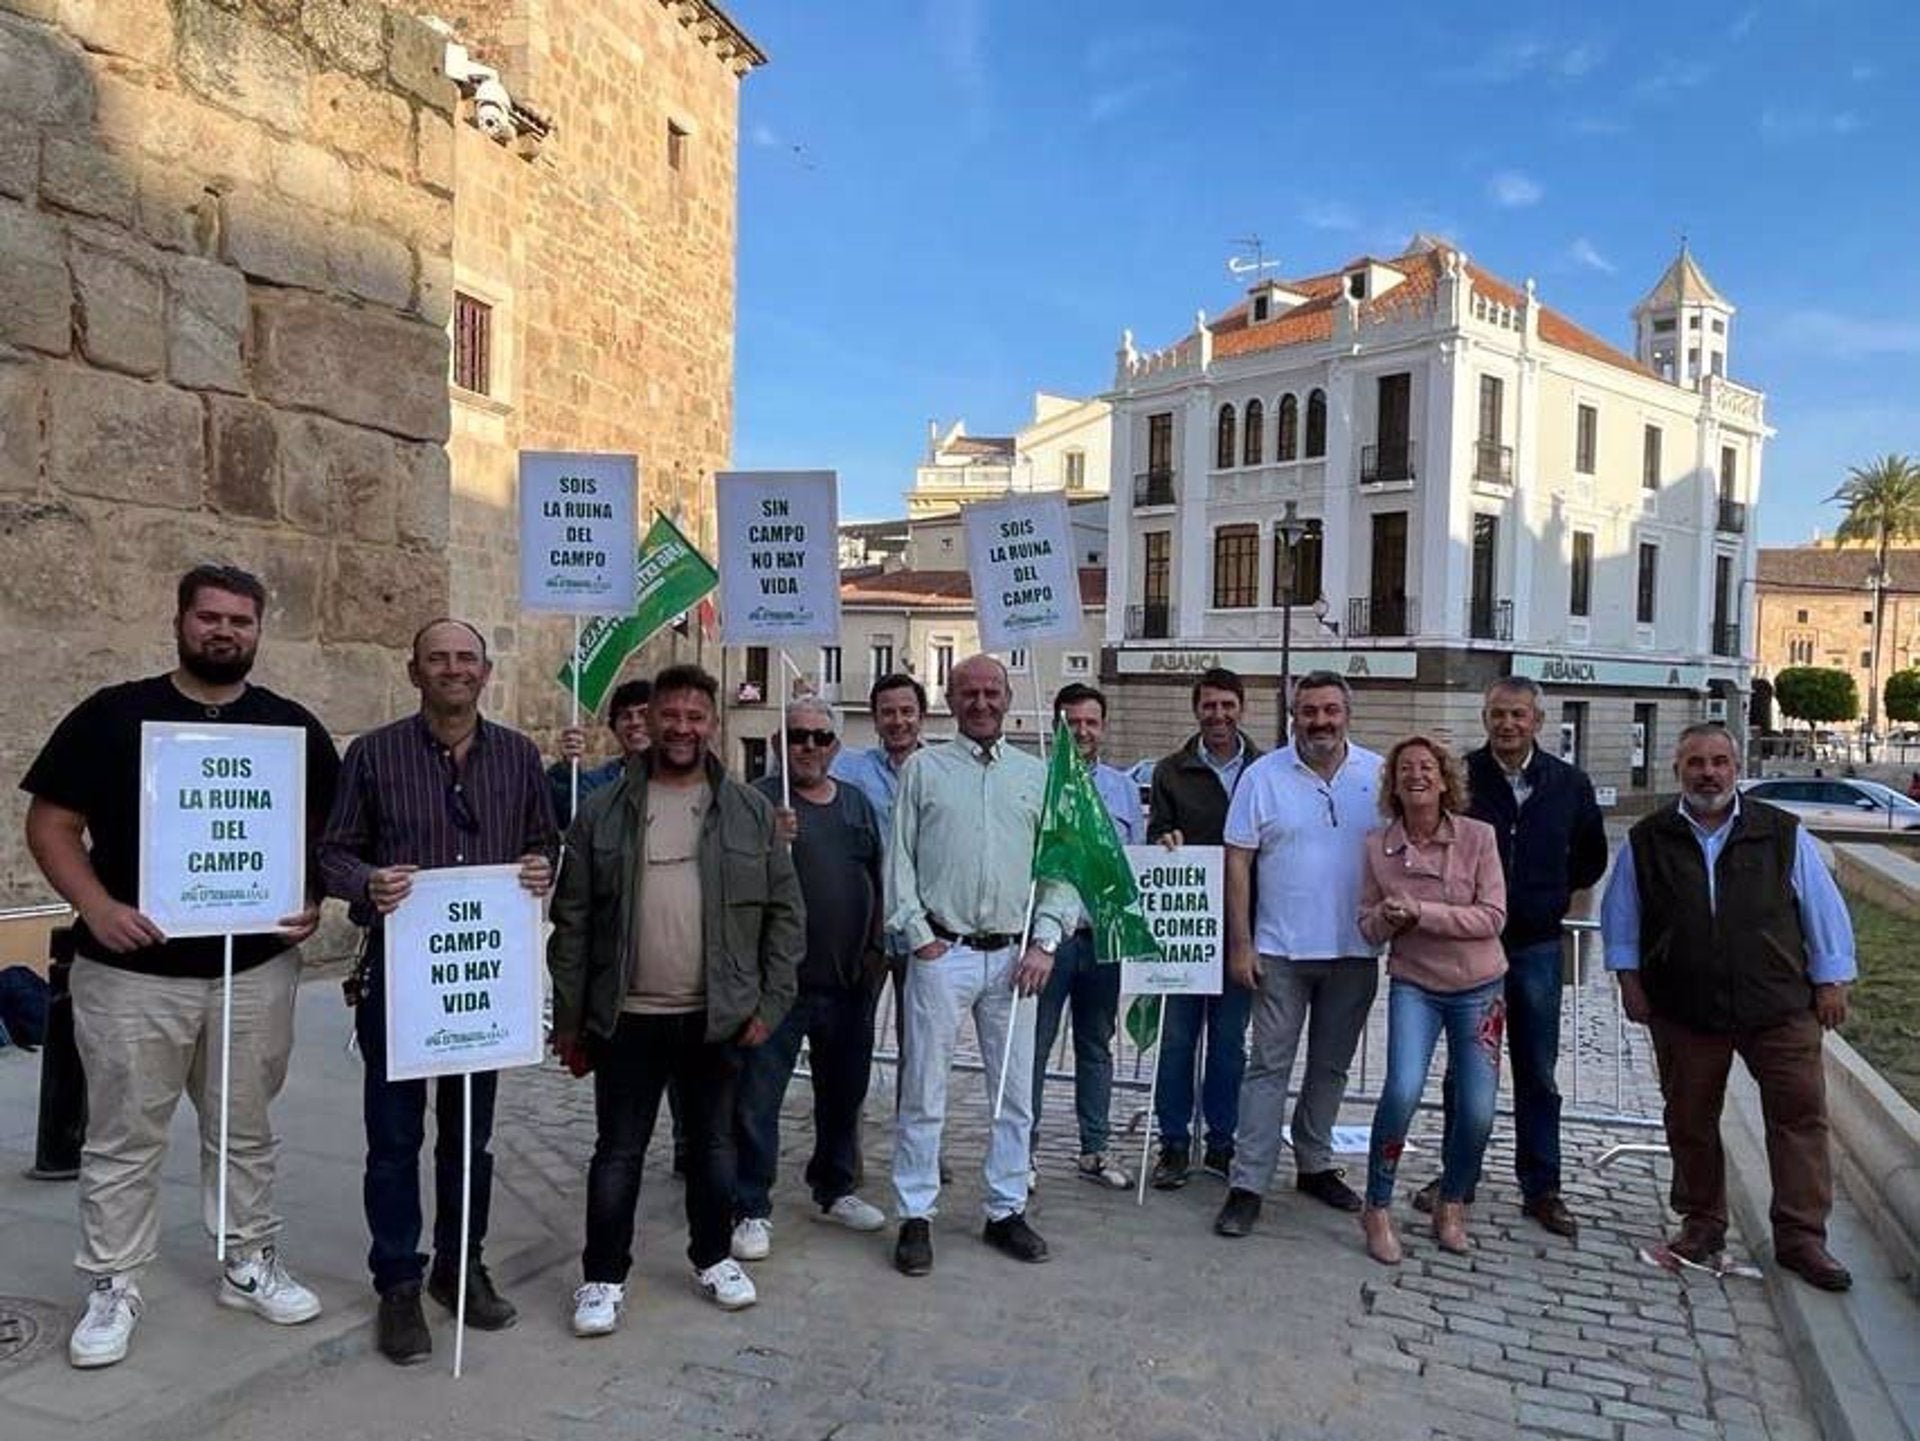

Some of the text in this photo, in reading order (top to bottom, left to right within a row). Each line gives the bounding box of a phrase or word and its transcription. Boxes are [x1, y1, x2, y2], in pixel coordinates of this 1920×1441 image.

[559, 477, 597, 494] SOIS
[543, 501, 613, 519] LA RUINA
[761, 500, 789, 518] SIN
[566, 526, 593, 543] DEL
[749, 525, 805, 543] CAMPO
[1000, 519, 1035, 538] SOIS
[550, 550, 606, 568] CAMPO
[752, 551, 806, 569] NO HAY
[990, 539, 1052, 563] LA RUINA
[1013, 565, 1039, 583] DEL
[760, 577, 799, 595] VIDA
[1002, 586, 1053, 607] CAMPO
[1150, 653, 1221, 671] ABANCA
[1541, 661, 1596, 681] ABANCA
[201, 757, 252, 778] SOIS
[179, 788, 273, 810] LA RUINA
[211, 820, 248, 840] DEL
[188, 851, 264, 873] CAMPO
[1140, 866, 1206, 889] ¿QUIÉN
[449, 901, 482, 922] SIN
[1153, 917, 1218, 938] COMER
[429, 930, 501, 954] CAMPO
[431, 959, 502, 985] NO HAY
[442, 990, 490, 1014] VIDA
